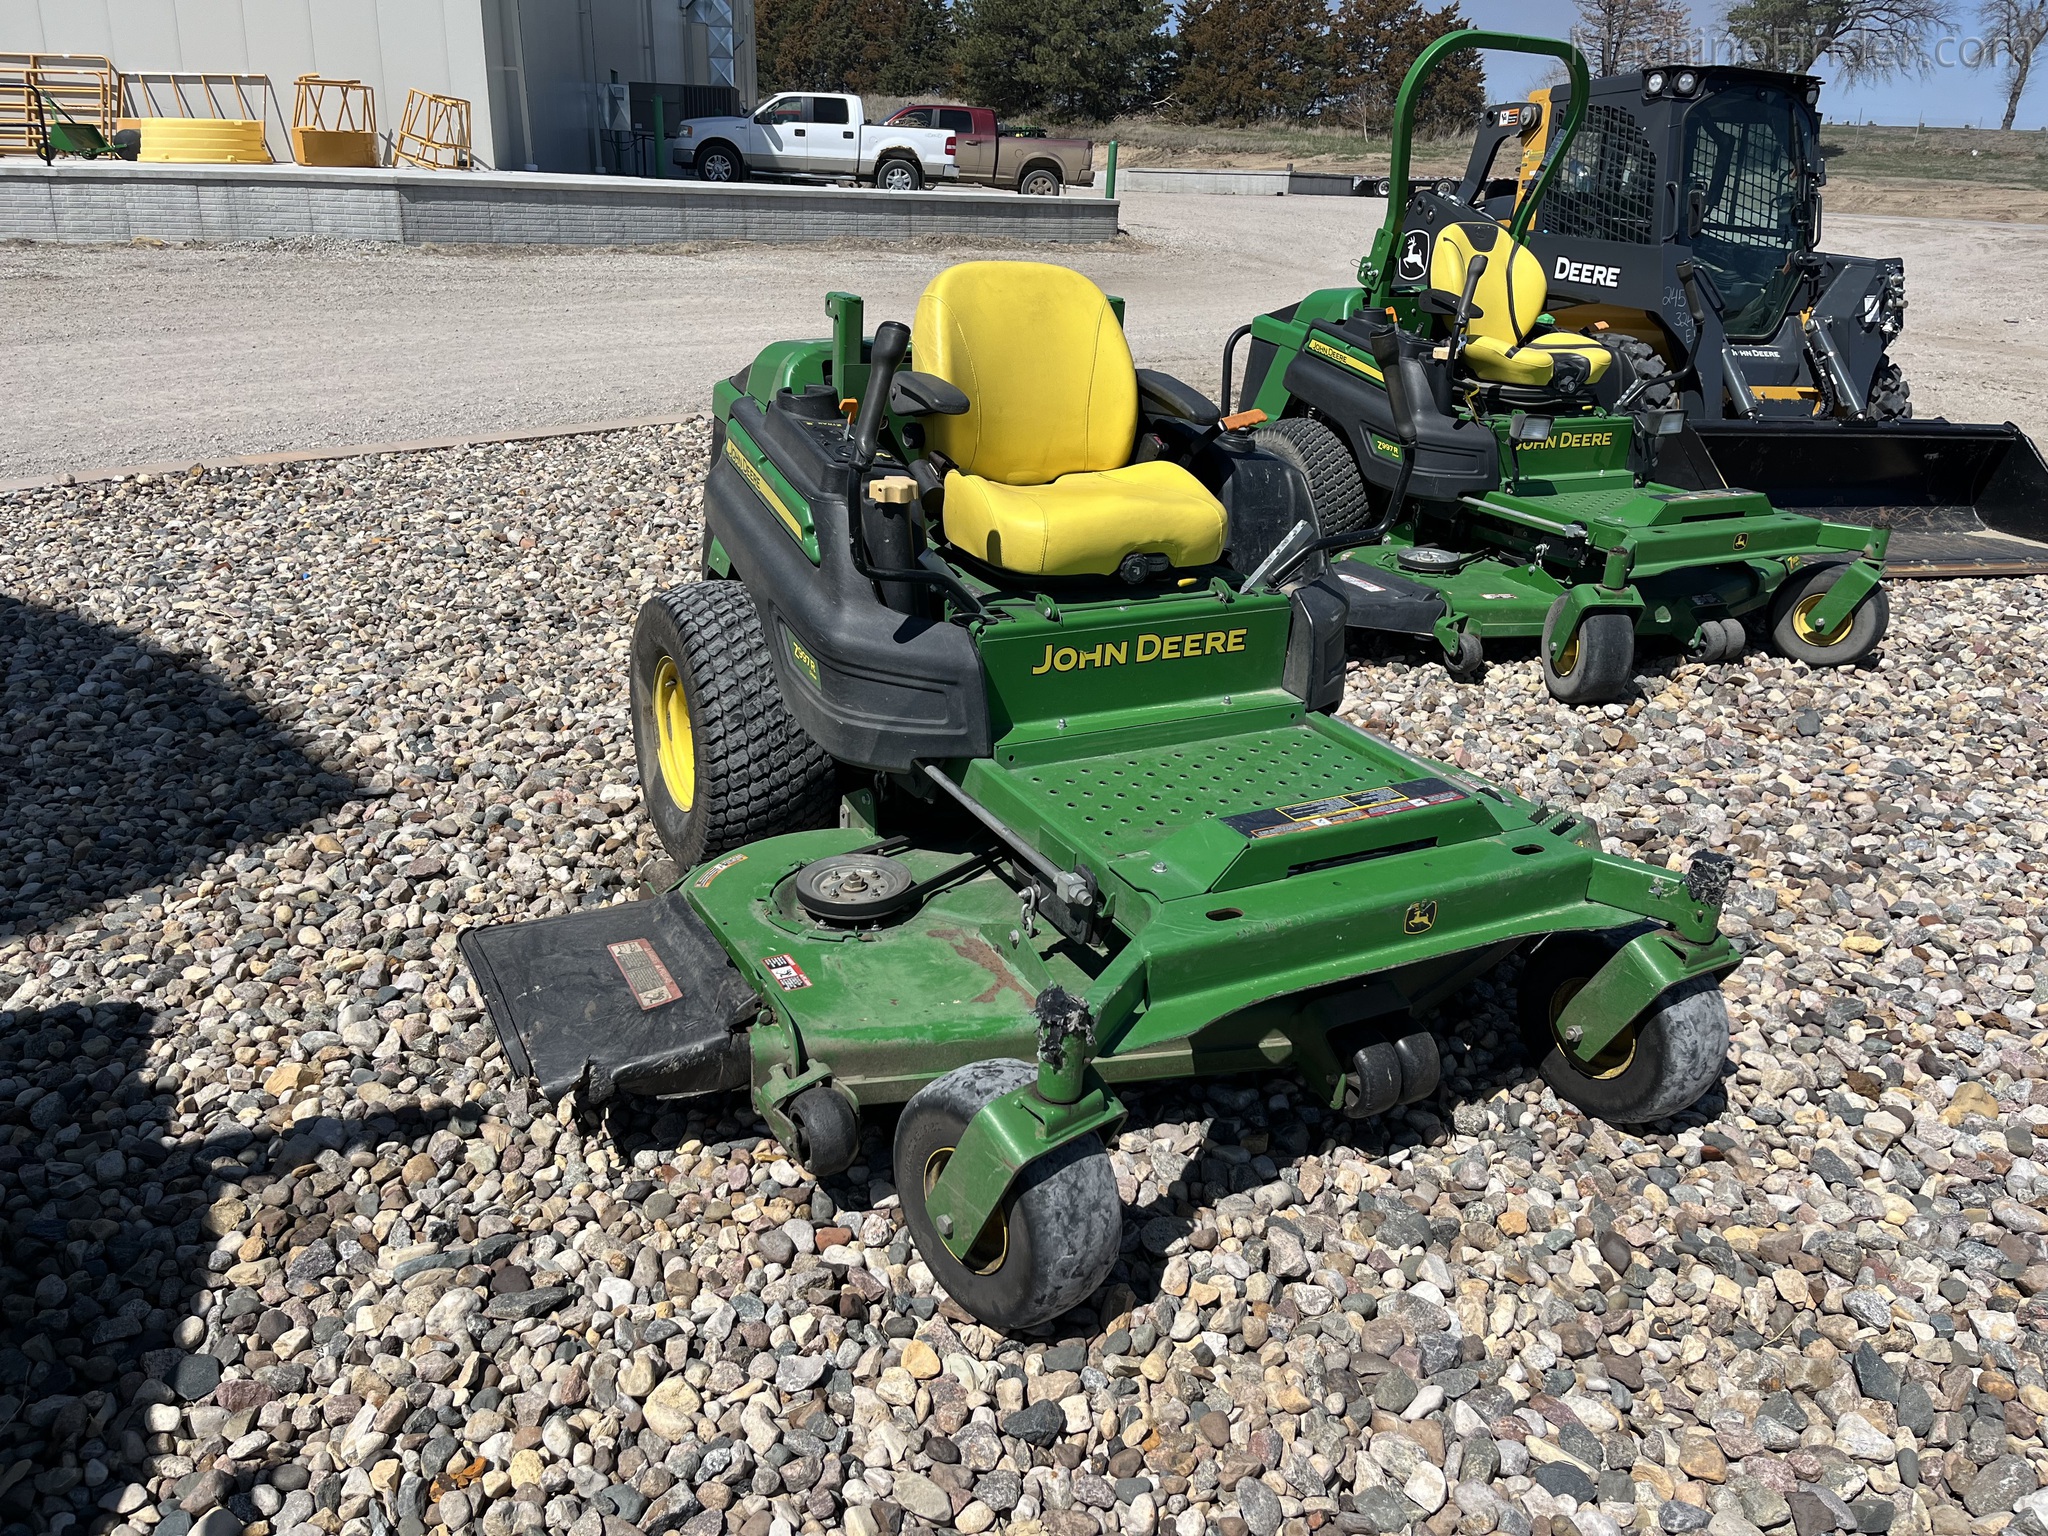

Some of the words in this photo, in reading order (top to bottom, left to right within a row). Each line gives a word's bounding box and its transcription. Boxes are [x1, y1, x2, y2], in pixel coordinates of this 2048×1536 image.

[1553, 255, 1621, 288] DEERE
[1662, 286, 1687, 307] 245
[1312, 341, 1329, 355] JOHN
[1328, 348, 1348, 364] DEERE
[1559, 432, 1613, 448] DEERE
[741, 457, 761, 490] DEERE
[1031, 641, 1128, 675] JOHN
[1135, 628, 1248, 663] DEERE
